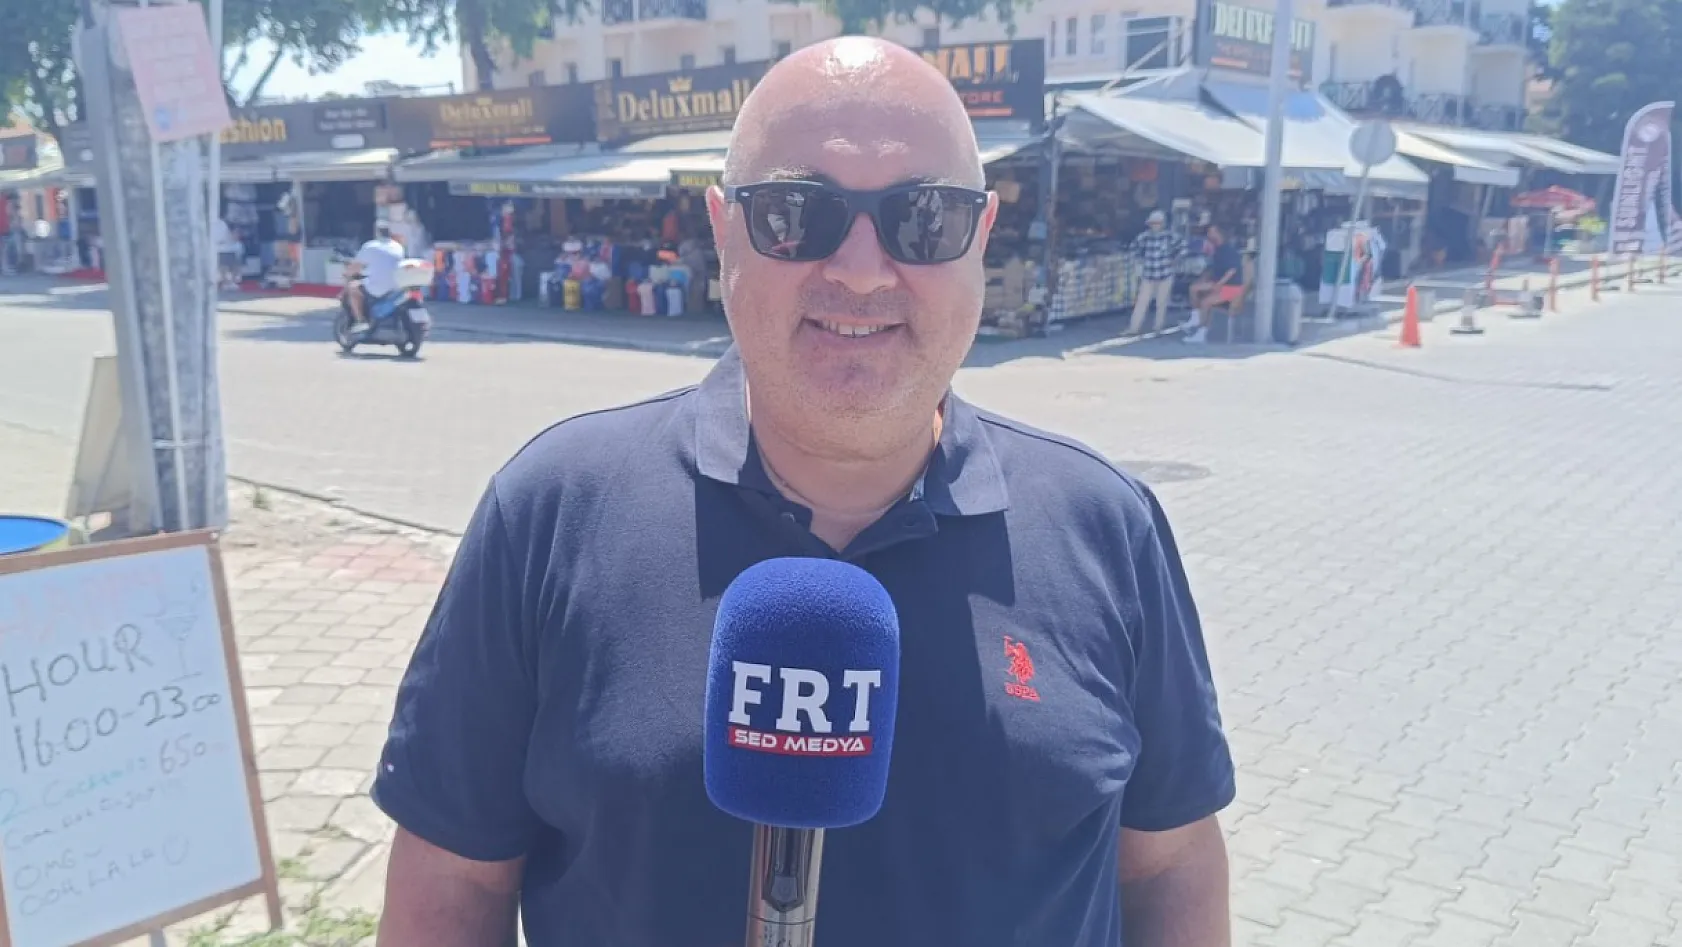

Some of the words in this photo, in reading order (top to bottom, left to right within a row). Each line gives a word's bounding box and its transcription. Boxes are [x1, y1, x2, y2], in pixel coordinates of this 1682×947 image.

[617, 78, 751, 123] Deluxmall
[220, 115, 287, 143] ashion
[1, 623, 154, 717] HOUR
[728, 661, 881, 734] FRT
[734, 730, 778, 749] SED
[783, 735, 866, 754] MEDYA
